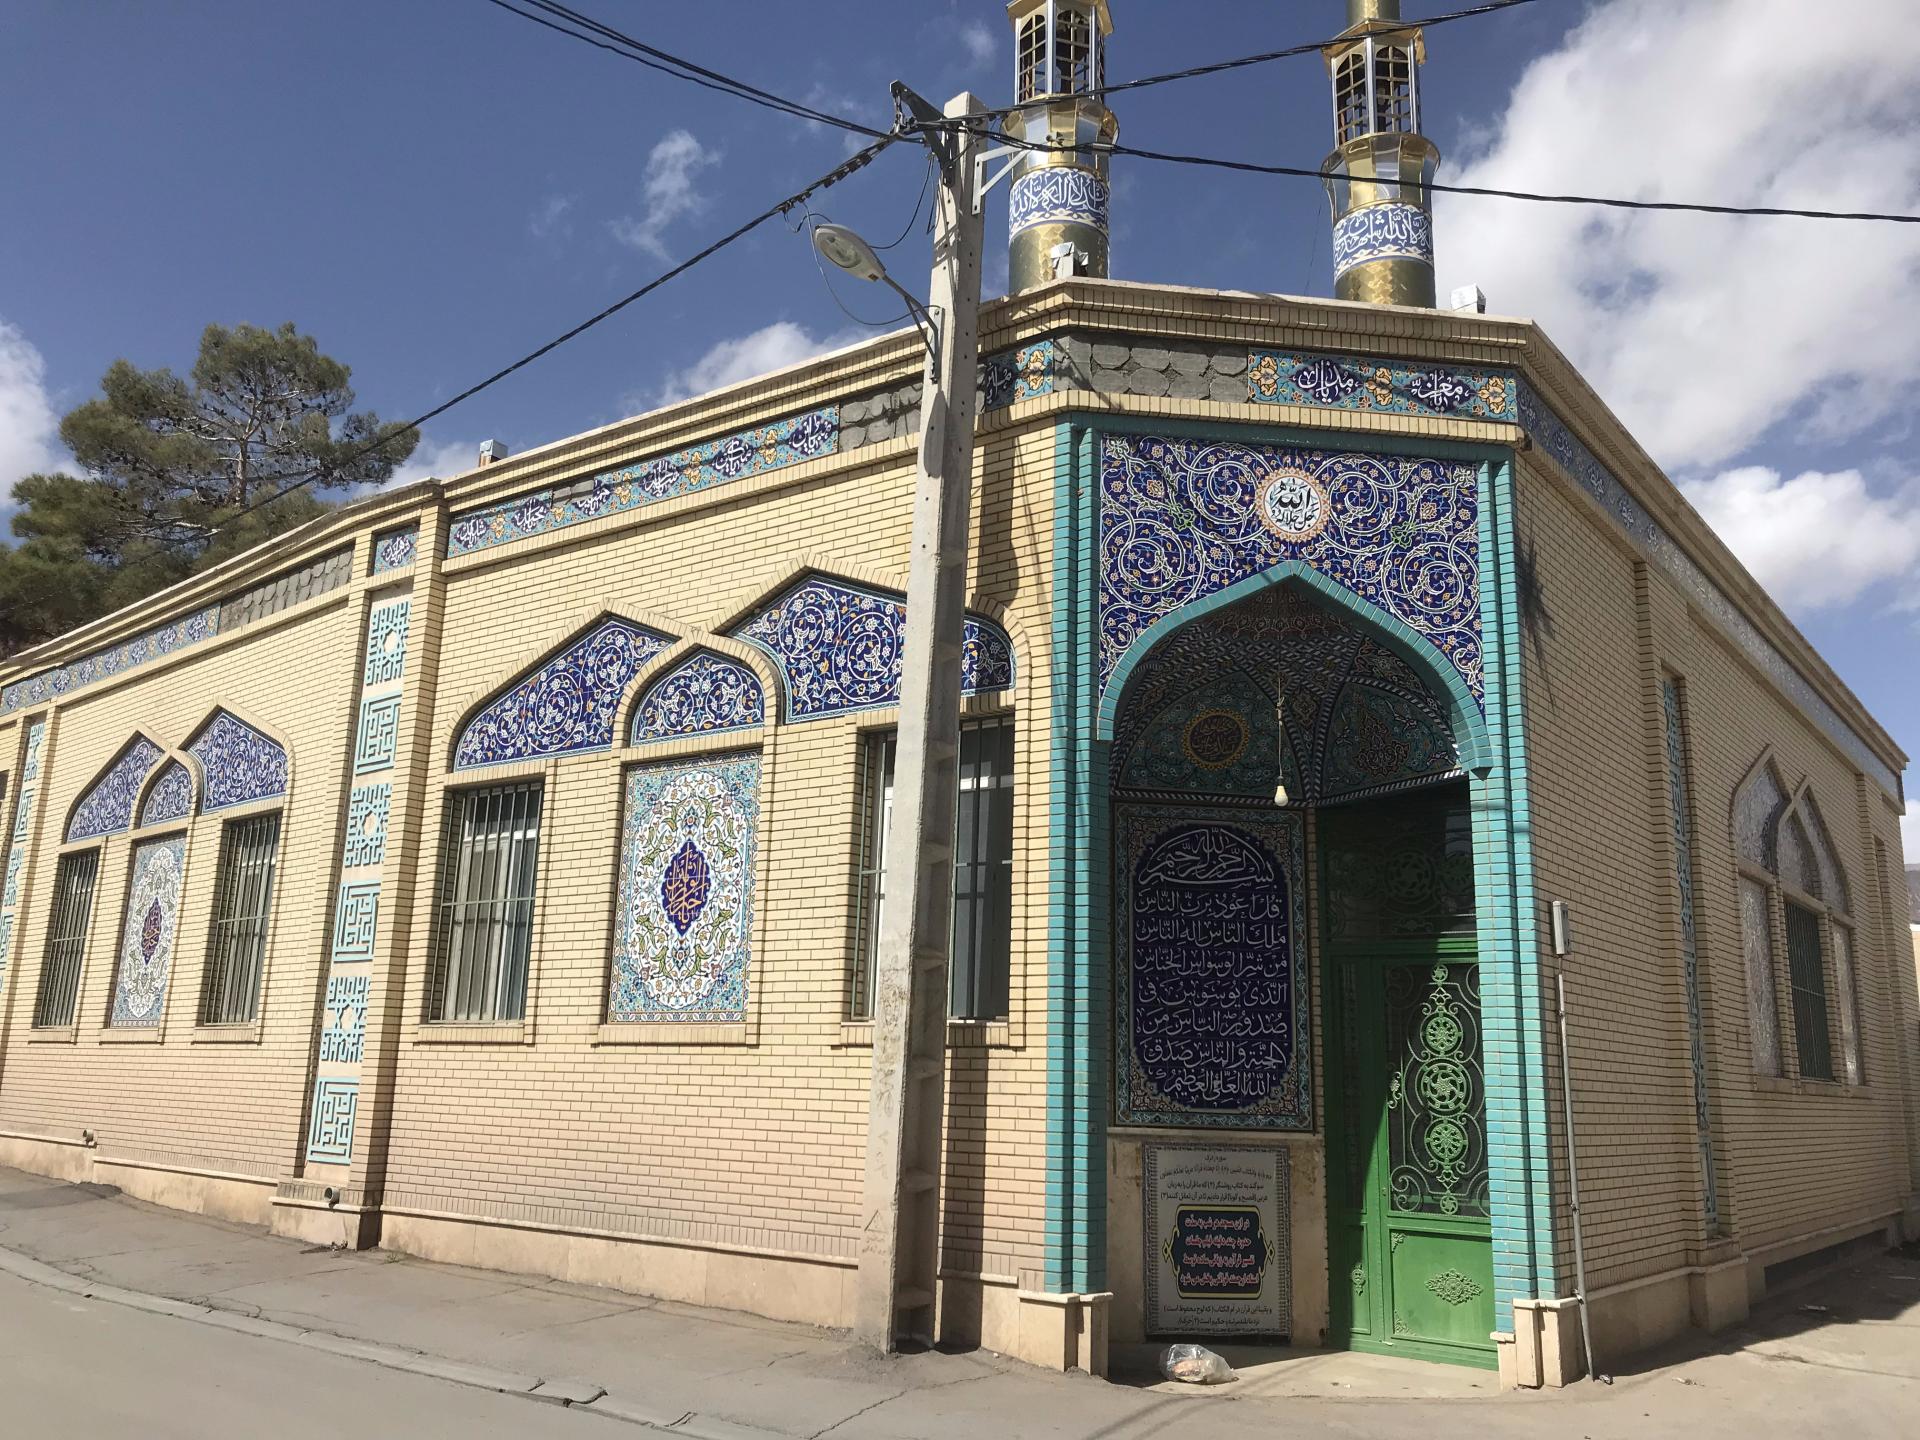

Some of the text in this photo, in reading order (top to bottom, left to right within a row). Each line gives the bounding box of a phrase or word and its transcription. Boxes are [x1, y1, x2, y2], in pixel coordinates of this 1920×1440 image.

[1269, 478, 1312, 510] الله
[1134, 890, 1180, 913] الناس
[1135, 919, 1180, 942] الناس
[1194, 920, 1247, 948] الناس
[1165, 1009, 1221, 1036] الناس
